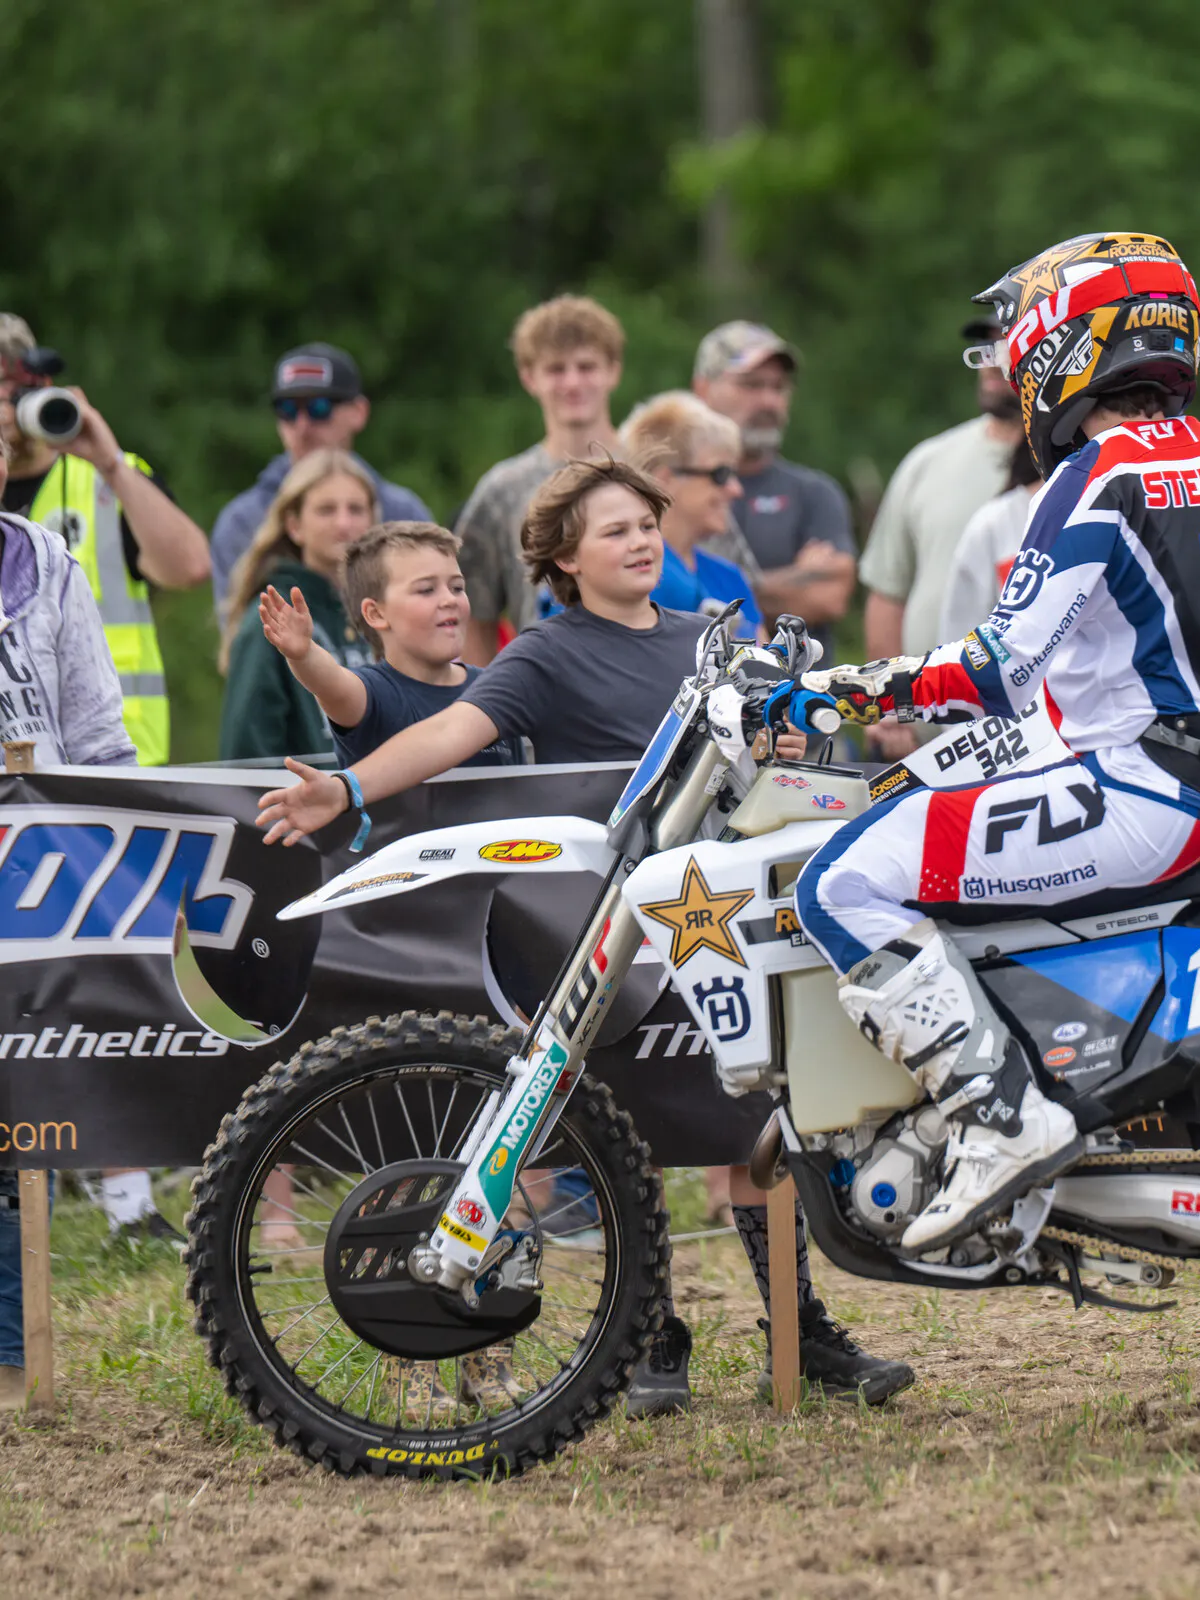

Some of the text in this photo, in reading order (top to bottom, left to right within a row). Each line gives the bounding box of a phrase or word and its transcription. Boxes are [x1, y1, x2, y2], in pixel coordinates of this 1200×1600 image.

[1110, 243, 1175, 260] ROCKSTAR
[1118, 256, 1147, 264] ENERGY
[1124, 303, 1190, 335] KORIE
[1138, 419, 1176, 441] FLY
[1026, 591, 1088, 673] Husqvarna
[975, 728, 1030, 779] 342
[870, 768, 909, 800] OCKSTAR
[812, 794, 836, 809] VP
[872, 789, 892, 805] NERGY
[985, 783, 1107, 855] FLY
[485, 841, 563, 860] FMF
[350, 871, 413, 890] ROCKSTAR
[987, 864, 1097, 895] Husqvarna
[1096, 912, 1159, 931] STEEDE
[635, 1020, 712, 1060] Th
[501, 1054, 563, 1150] MOTOREX
[366, 1442, 486, 1466] DUNLOP
